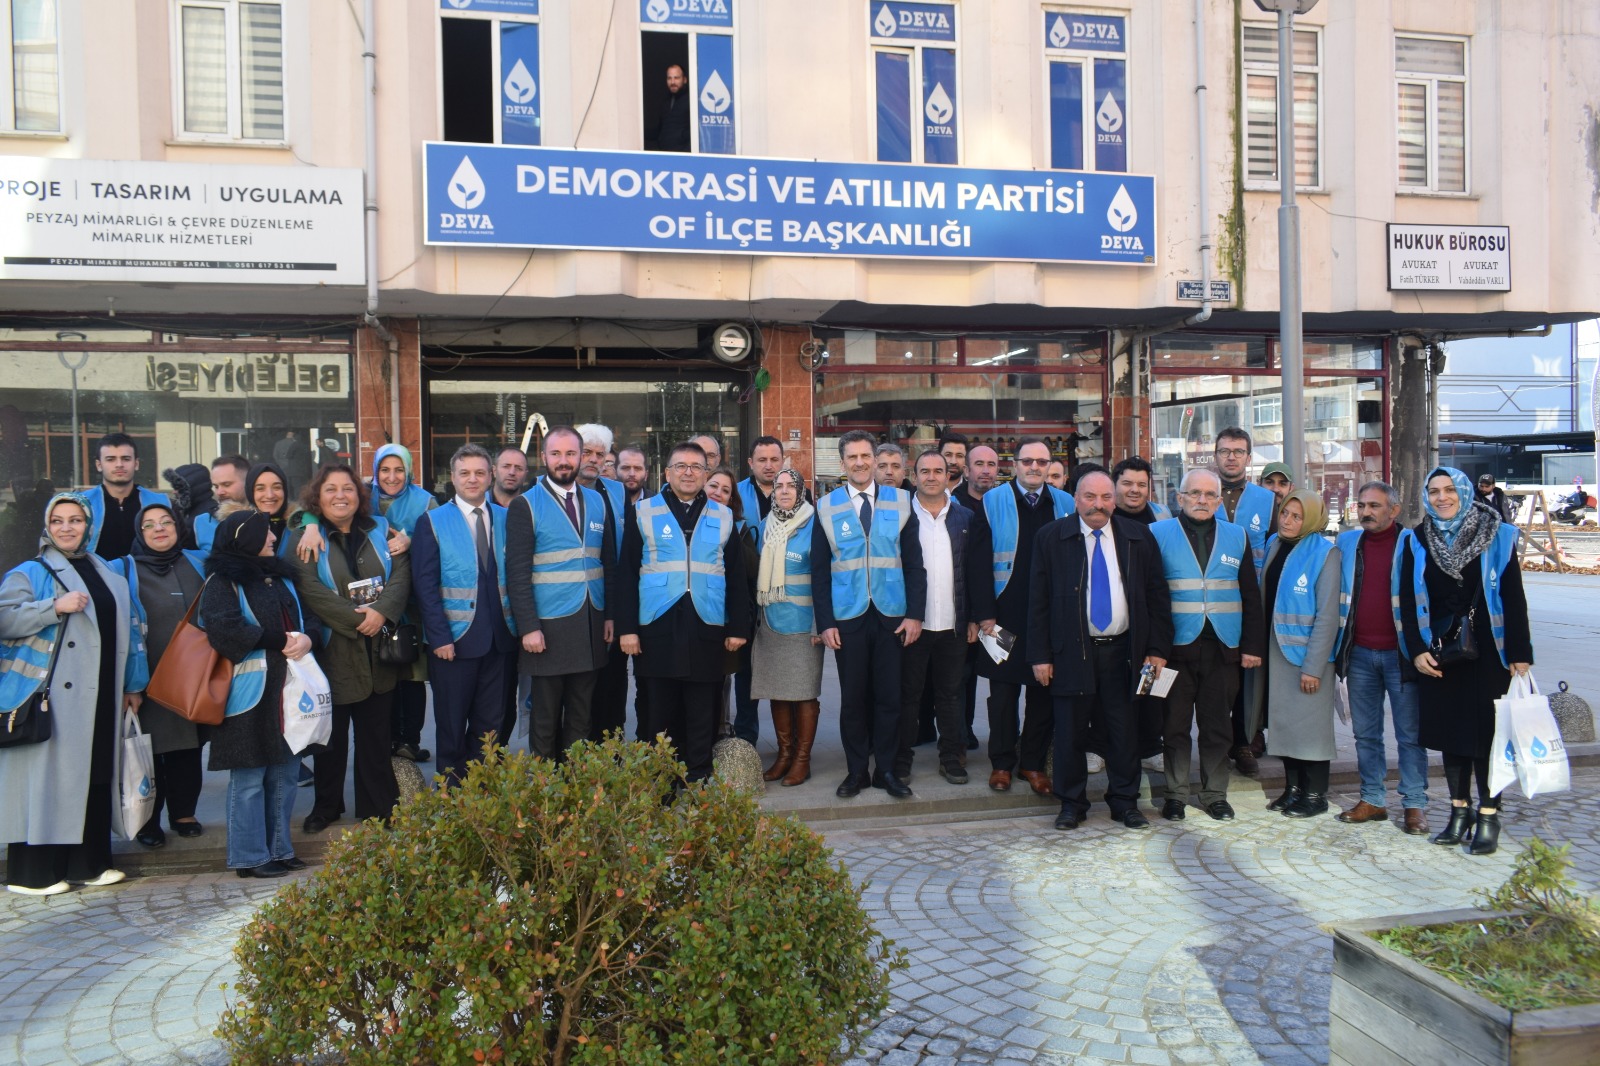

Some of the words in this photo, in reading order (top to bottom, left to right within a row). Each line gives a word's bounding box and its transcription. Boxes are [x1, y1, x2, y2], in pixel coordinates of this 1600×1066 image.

[673, 0, 728, 13] DEVA
[899, 10, 950, 28] DEVA
[1072, 22, 1120, 39] DEVA
[505, 104, 536, 115] DEVA
[702, 114, 730, 125] DEVA
[926, 125, 953, 135] DEVA
[1097, 133, 1122, 143] DEVA
[91, 182, 192, 201] TASARIM
[220, 186, 343, 205] UYGULAMA
[516, 165, 757, 202] DEMOKRASİ
[766, 175, 815, 205] VE
[824, 178, 945, 209] ATILIM
[957, 178, 1084, 214] PARTİSİ
[26, 212, 78, 227] PEYZAJ
[83, 211, 163, 227] MİMARLIĞI
[167, 217, 176, 226] &
[181, 217, 226, 230] ÇEVRE
[231, 215, 314, 230] DÜZENLEME
[440, 213, 494, 230] DEVA
[649, 215, 695, 239] OF
[706, 211, 772, 247] İLÇE
[783, 220, 971, 250] BAŞKANLIĞI
[92, 230, 165, 244] MİMARLIK
[170, 231, 253, 246] HİZMETLERİ
[1101, 235, 1144, 250] DEVA
[1394, 233, 1444, 250] HUKUK
[1449, 231, 1506, 251] BÜROSU
[50, 258, 83, 266] PEYZAJ
[1402, 260, 1438, 269] AVUKAT
[1463, 261, 1499, 270] AVUKAT
[1414, 274, 1440, 284] TÜRKER
[316, 692, 331, 705] DE
